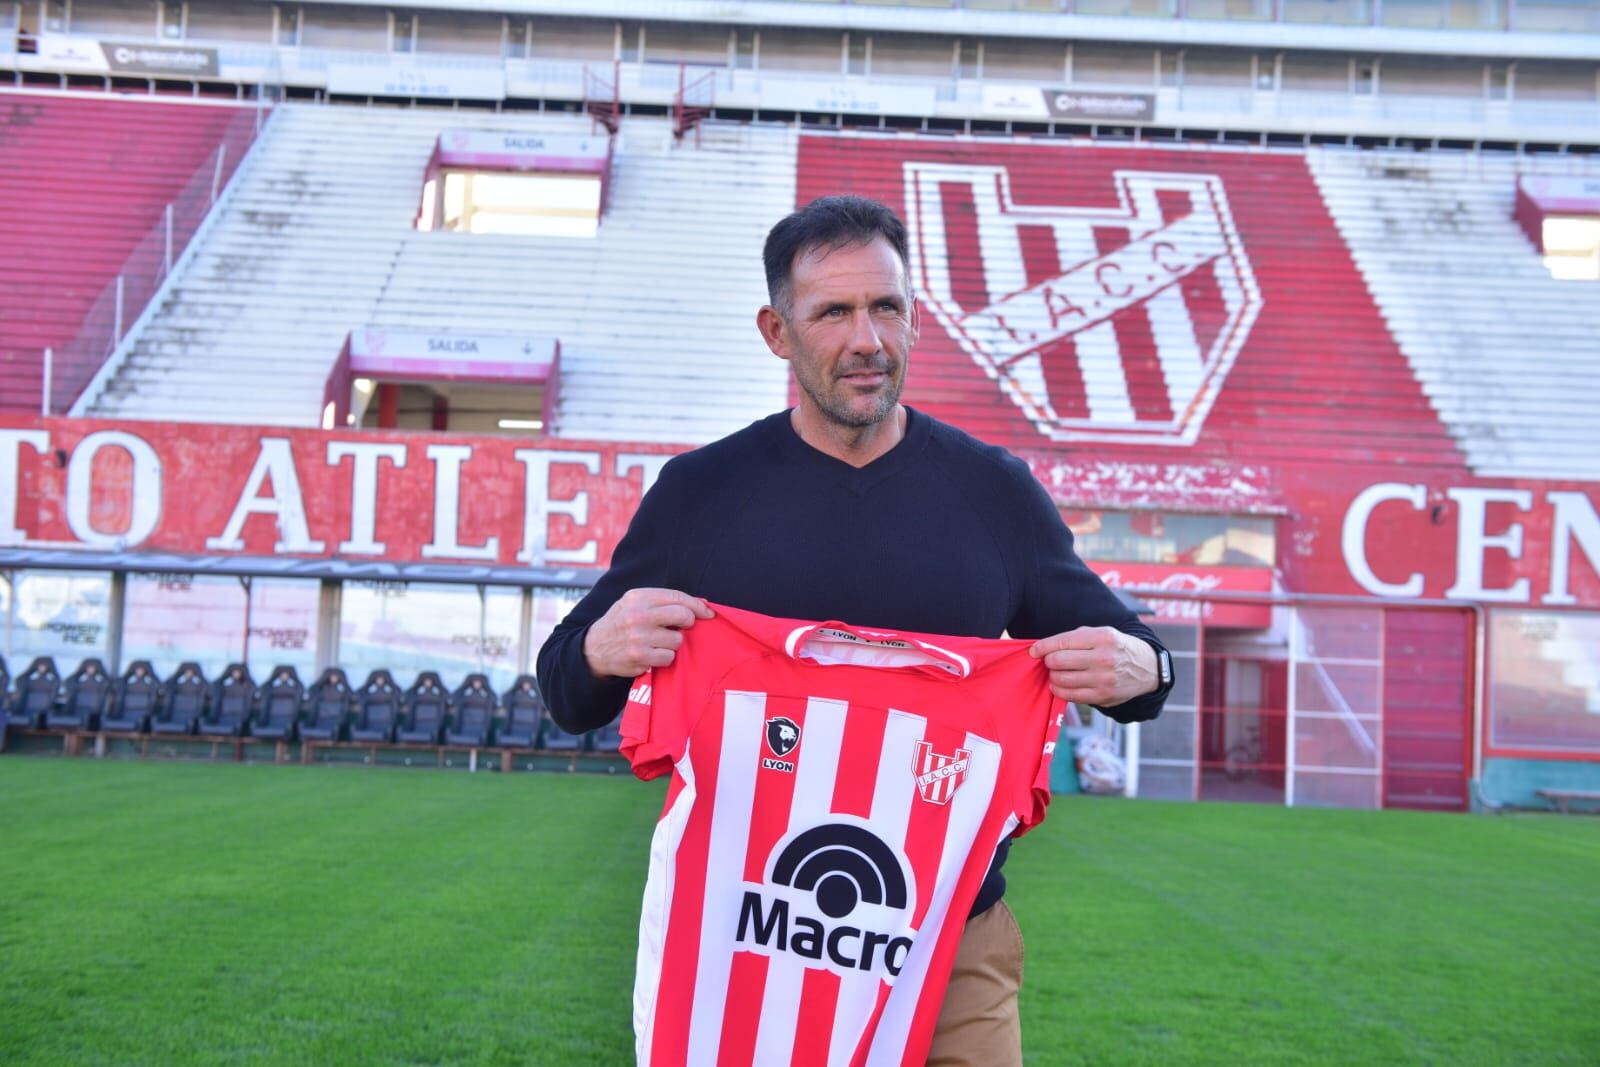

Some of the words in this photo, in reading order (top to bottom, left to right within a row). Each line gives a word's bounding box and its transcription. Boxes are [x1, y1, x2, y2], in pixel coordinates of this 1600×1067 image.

[504, 137, 545, 149] SALIDA
[427, 339, 479, 353] SALIDA
[832, 631, 857, 642] LYON
[880, 640, 905, 649] LYON
[763, 758, 794, 773] LYON
[735, 891, 914, 977] Macro
